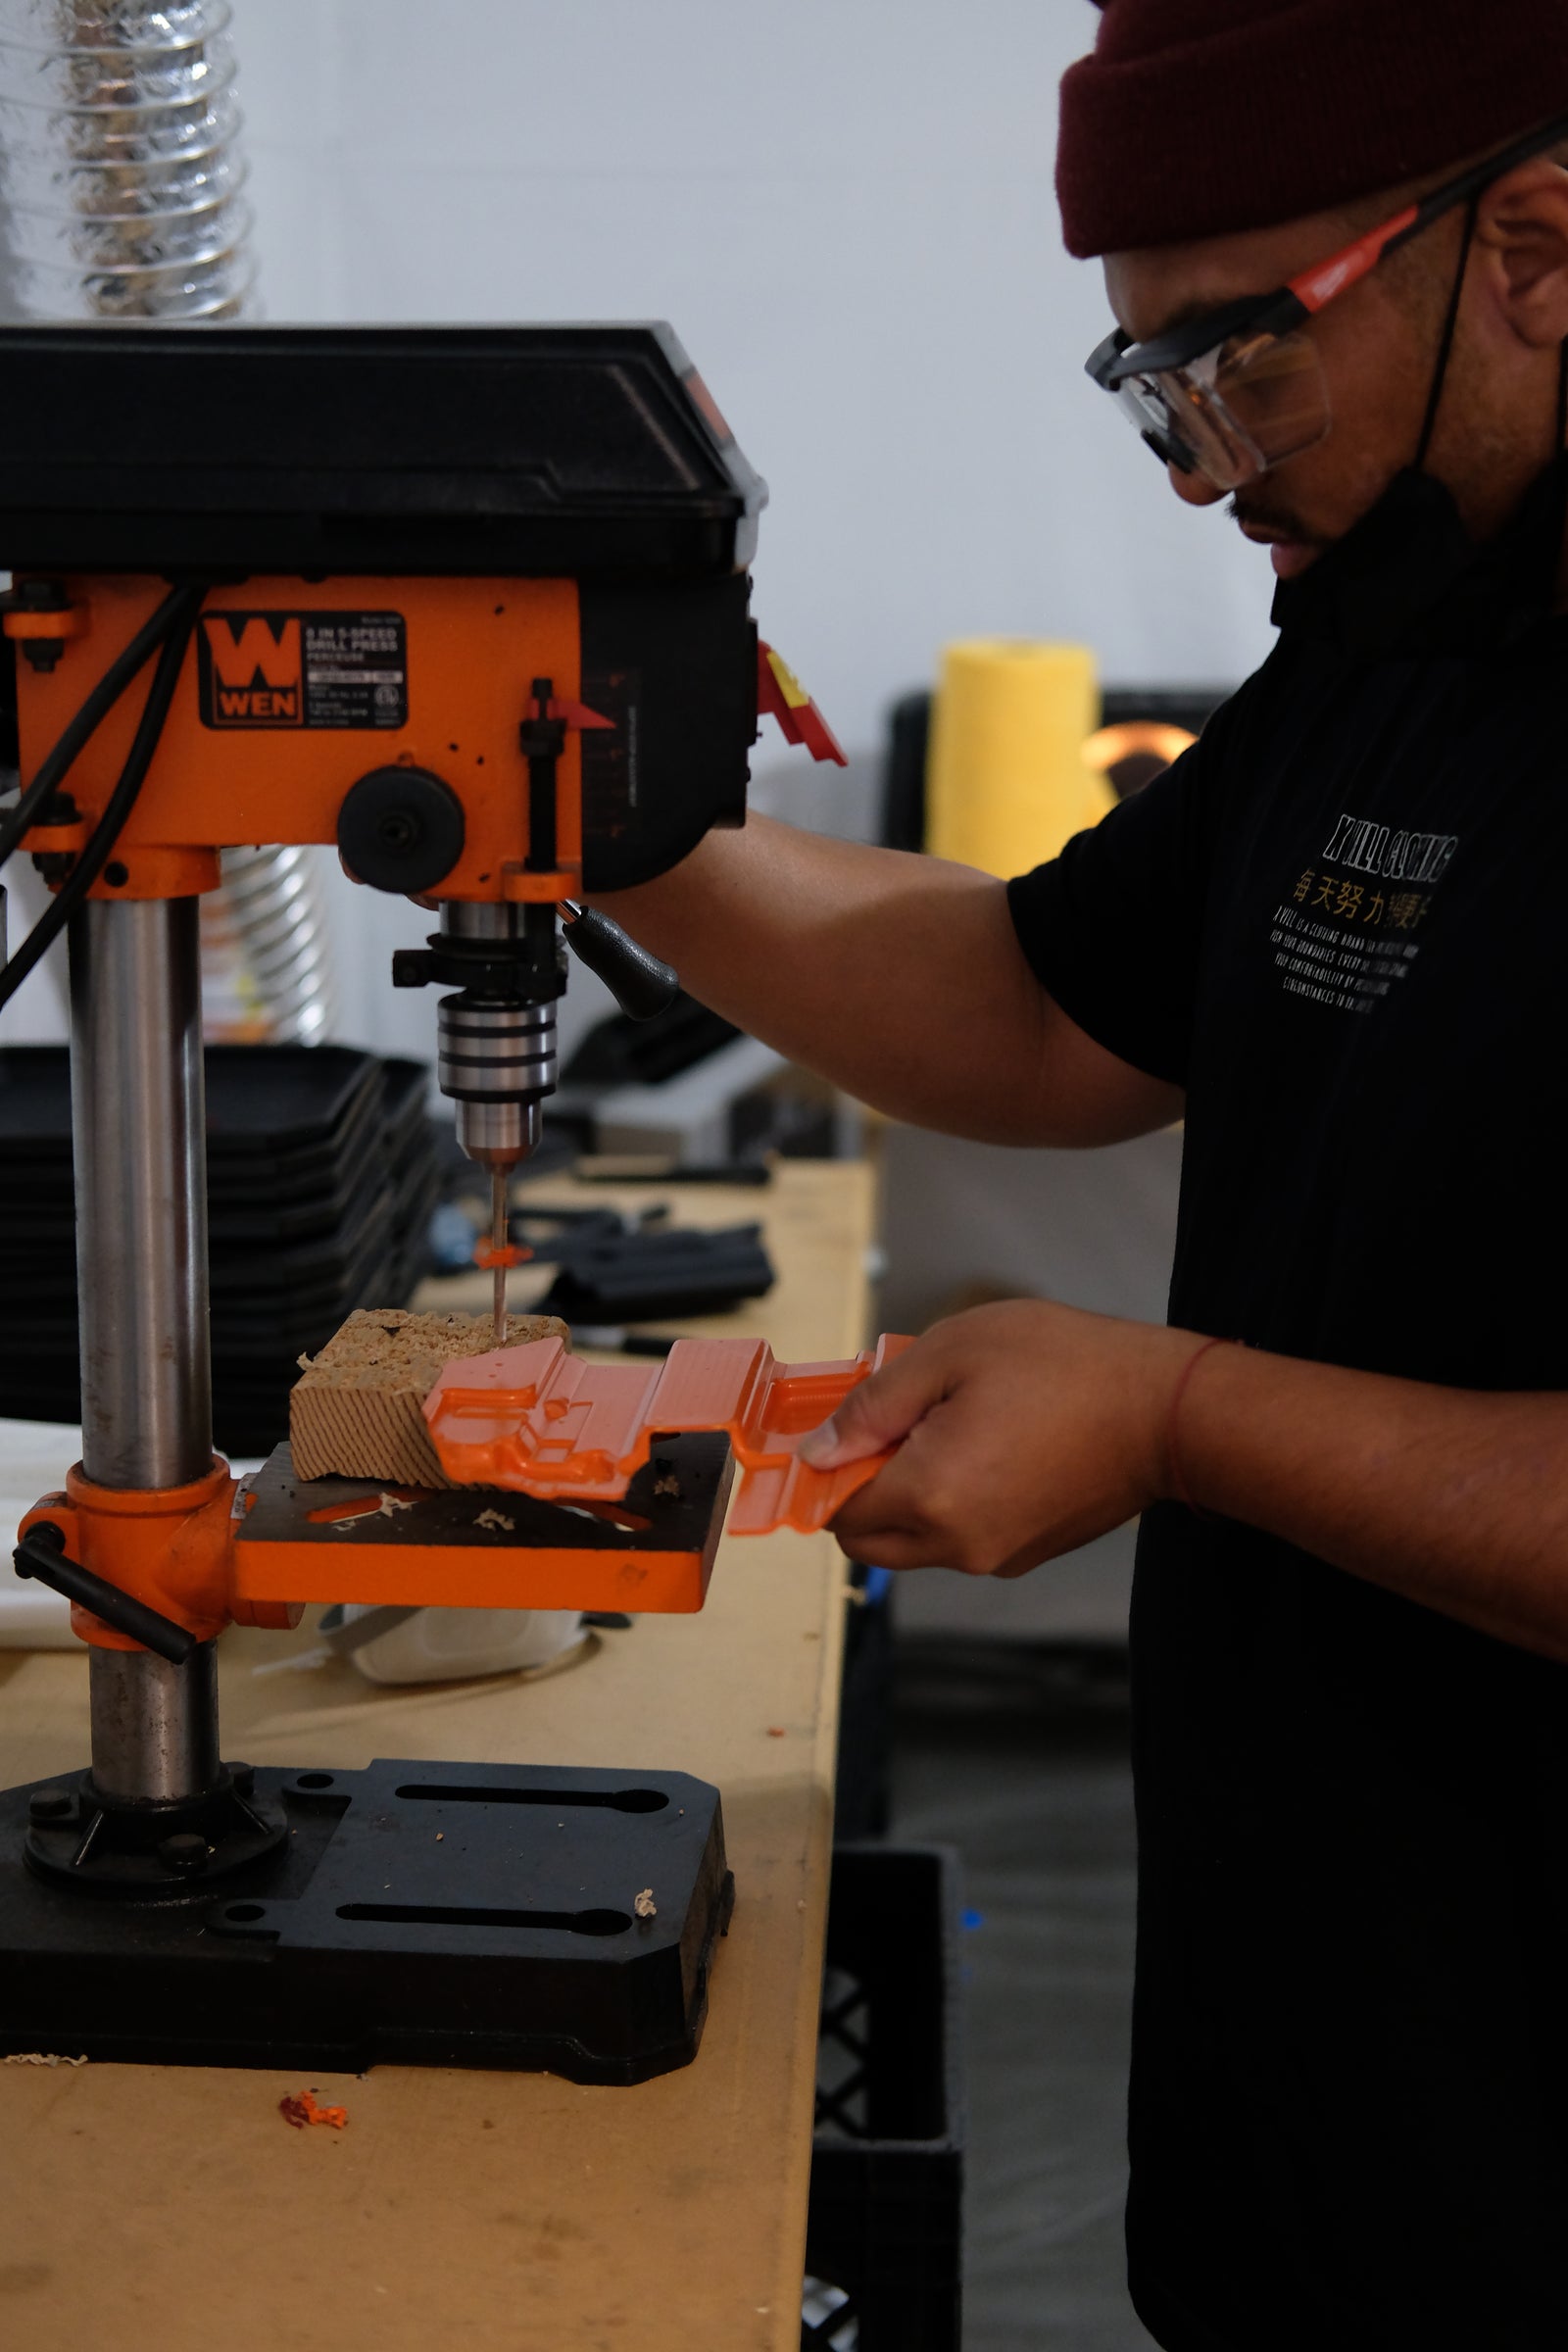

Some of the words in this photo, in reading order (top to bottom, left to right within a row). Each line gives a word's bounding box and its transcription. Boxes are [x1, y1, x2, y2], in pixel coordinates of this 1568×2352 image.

[306, 640, 347, 651] DRILL
[351, 640, 398, 652] PRESS
[219, 691, 295, 716] WEN
[1340, 933, 1365, 951] BRAND
[1288, 957, 1346, 986] COMFORTABILITY
[1282, 976, 1336, 1004] CIRCUMSTANCES
